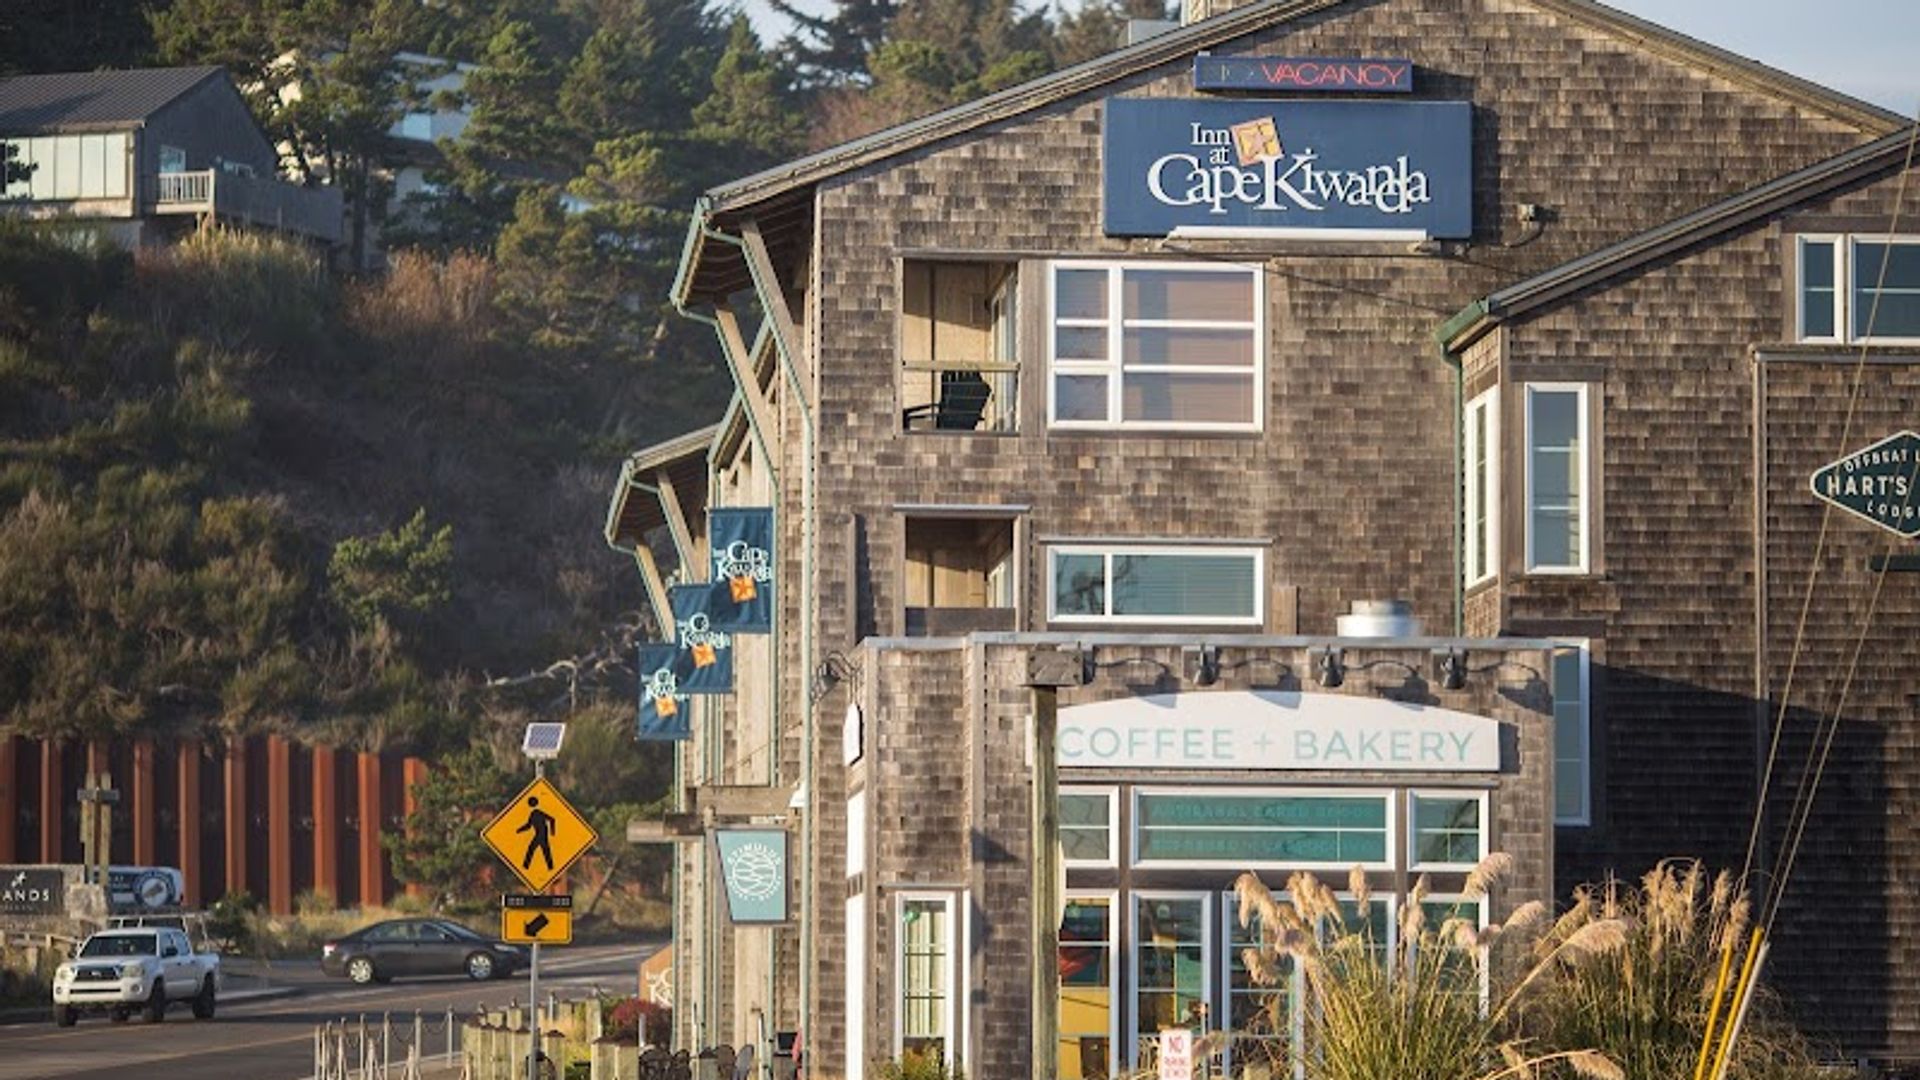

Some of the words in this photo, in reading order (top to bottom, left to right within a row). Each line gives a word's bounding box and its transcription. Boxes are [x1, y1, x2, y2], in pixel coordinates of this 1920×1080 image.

[1262, 62, 1405, 86] VACANCY
[1190, 122, 1232, 146] Inn
[1209, 147, 1229, 164] at
[1146, 153, 1261, 214] Cape
[1253, 148, 1431, 213] Kiwanda
[1844, 449, 1907, 472] OFFBEAT
[1826, 475, 1908, 497] HART'S
[1059, 725, 1235, 760] COFFEE
[1294, 730, 1475, 762] BAKERY
[1168, 1035, 1184, 1054] NO
